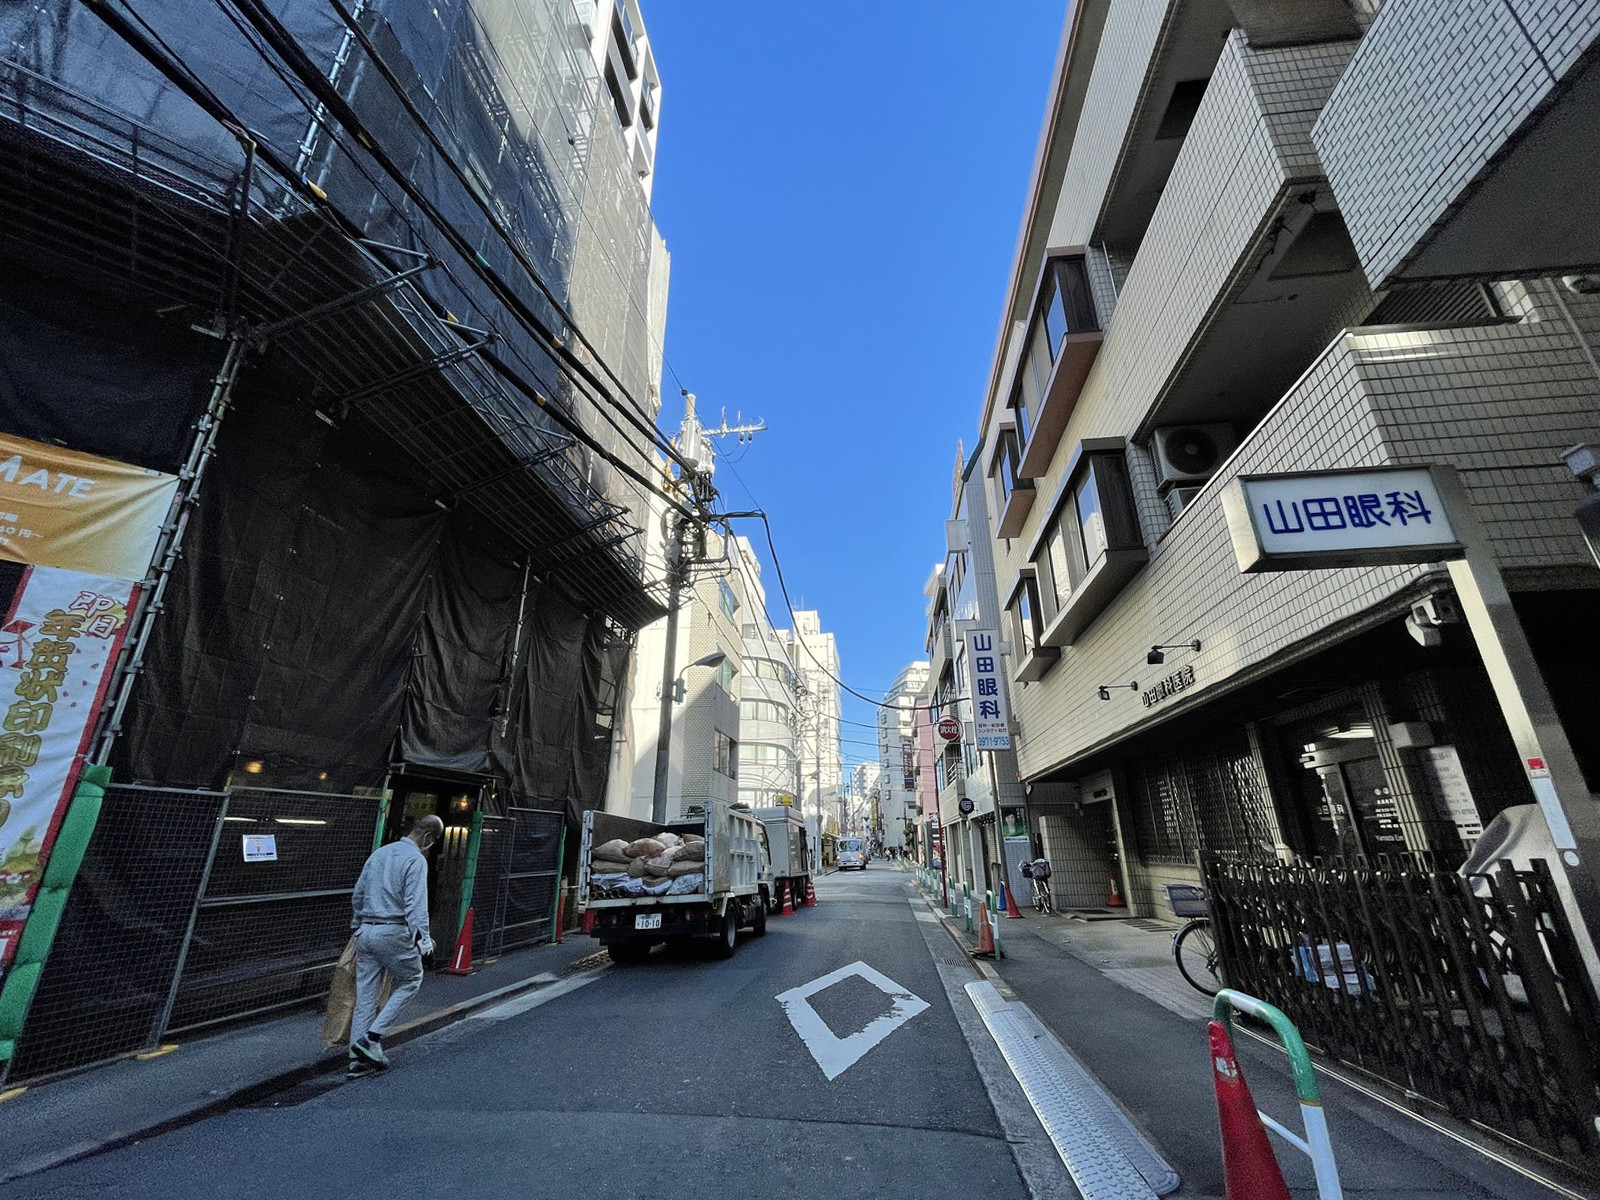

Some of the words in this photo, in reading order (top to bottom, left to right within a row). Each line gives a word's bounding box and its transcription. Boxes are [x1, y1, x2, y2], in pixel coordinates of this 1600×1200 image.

[1263, 490, 1431, 534] 山田眼科
[69, 591, 118, 639] 即日
[973, 633, 1001, 719] 山田眼科
[1141, 664, 1196, 708] 山田眼科医院
[978, 736, 1010, 746] 3971-9753
